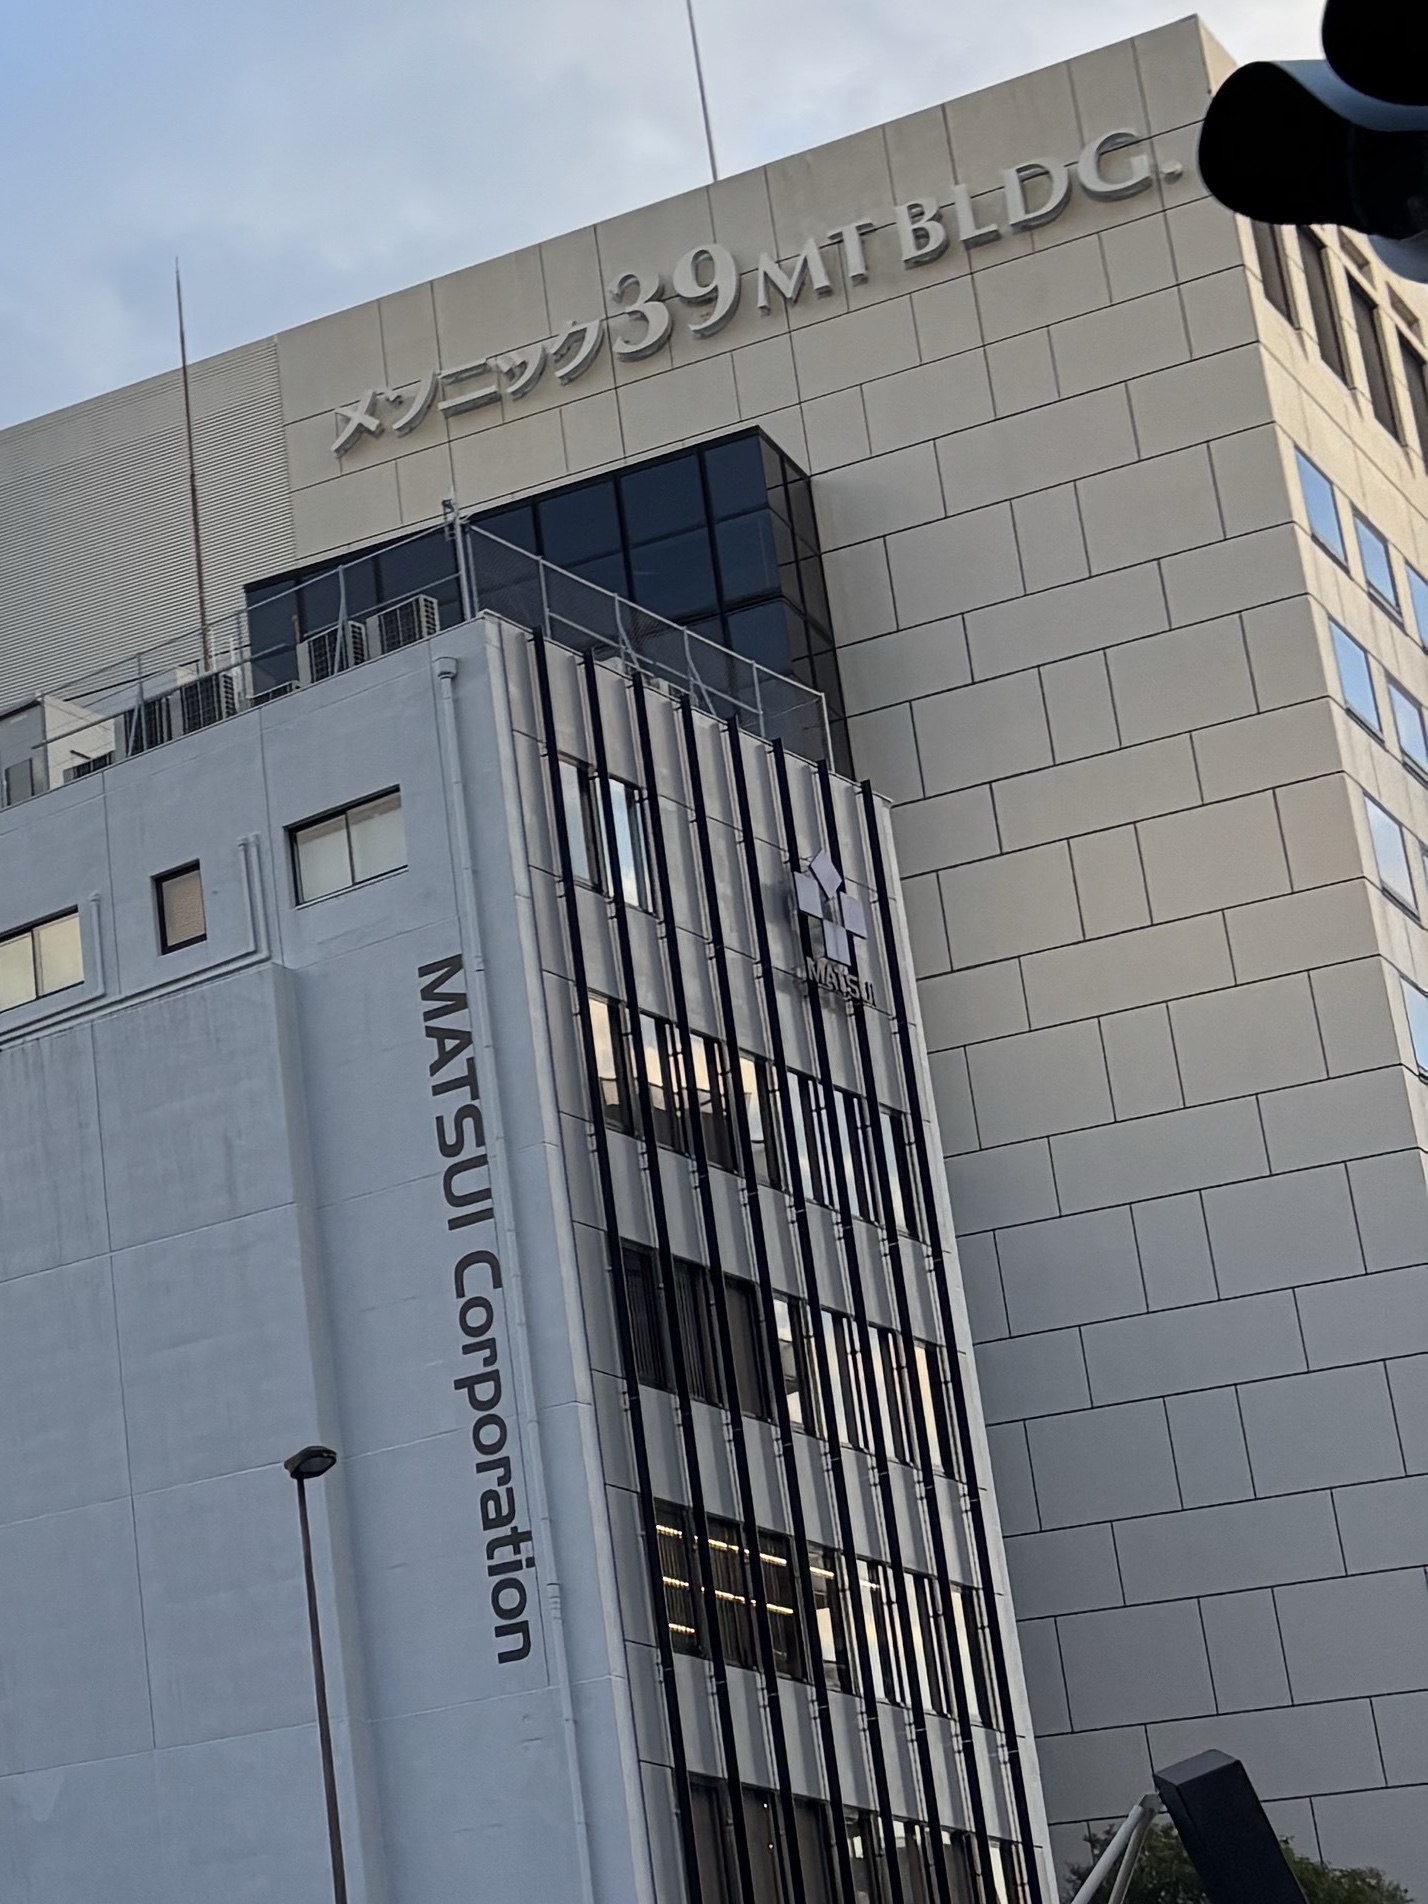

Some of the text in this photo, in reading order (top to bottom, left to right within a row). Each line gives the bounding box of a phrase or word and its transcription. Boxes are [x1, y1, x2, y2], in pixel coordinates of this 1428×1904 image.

[894, 128, 1185, 270] BLDG.
[417, 953, 536, 1665] MATSUI Corporation
